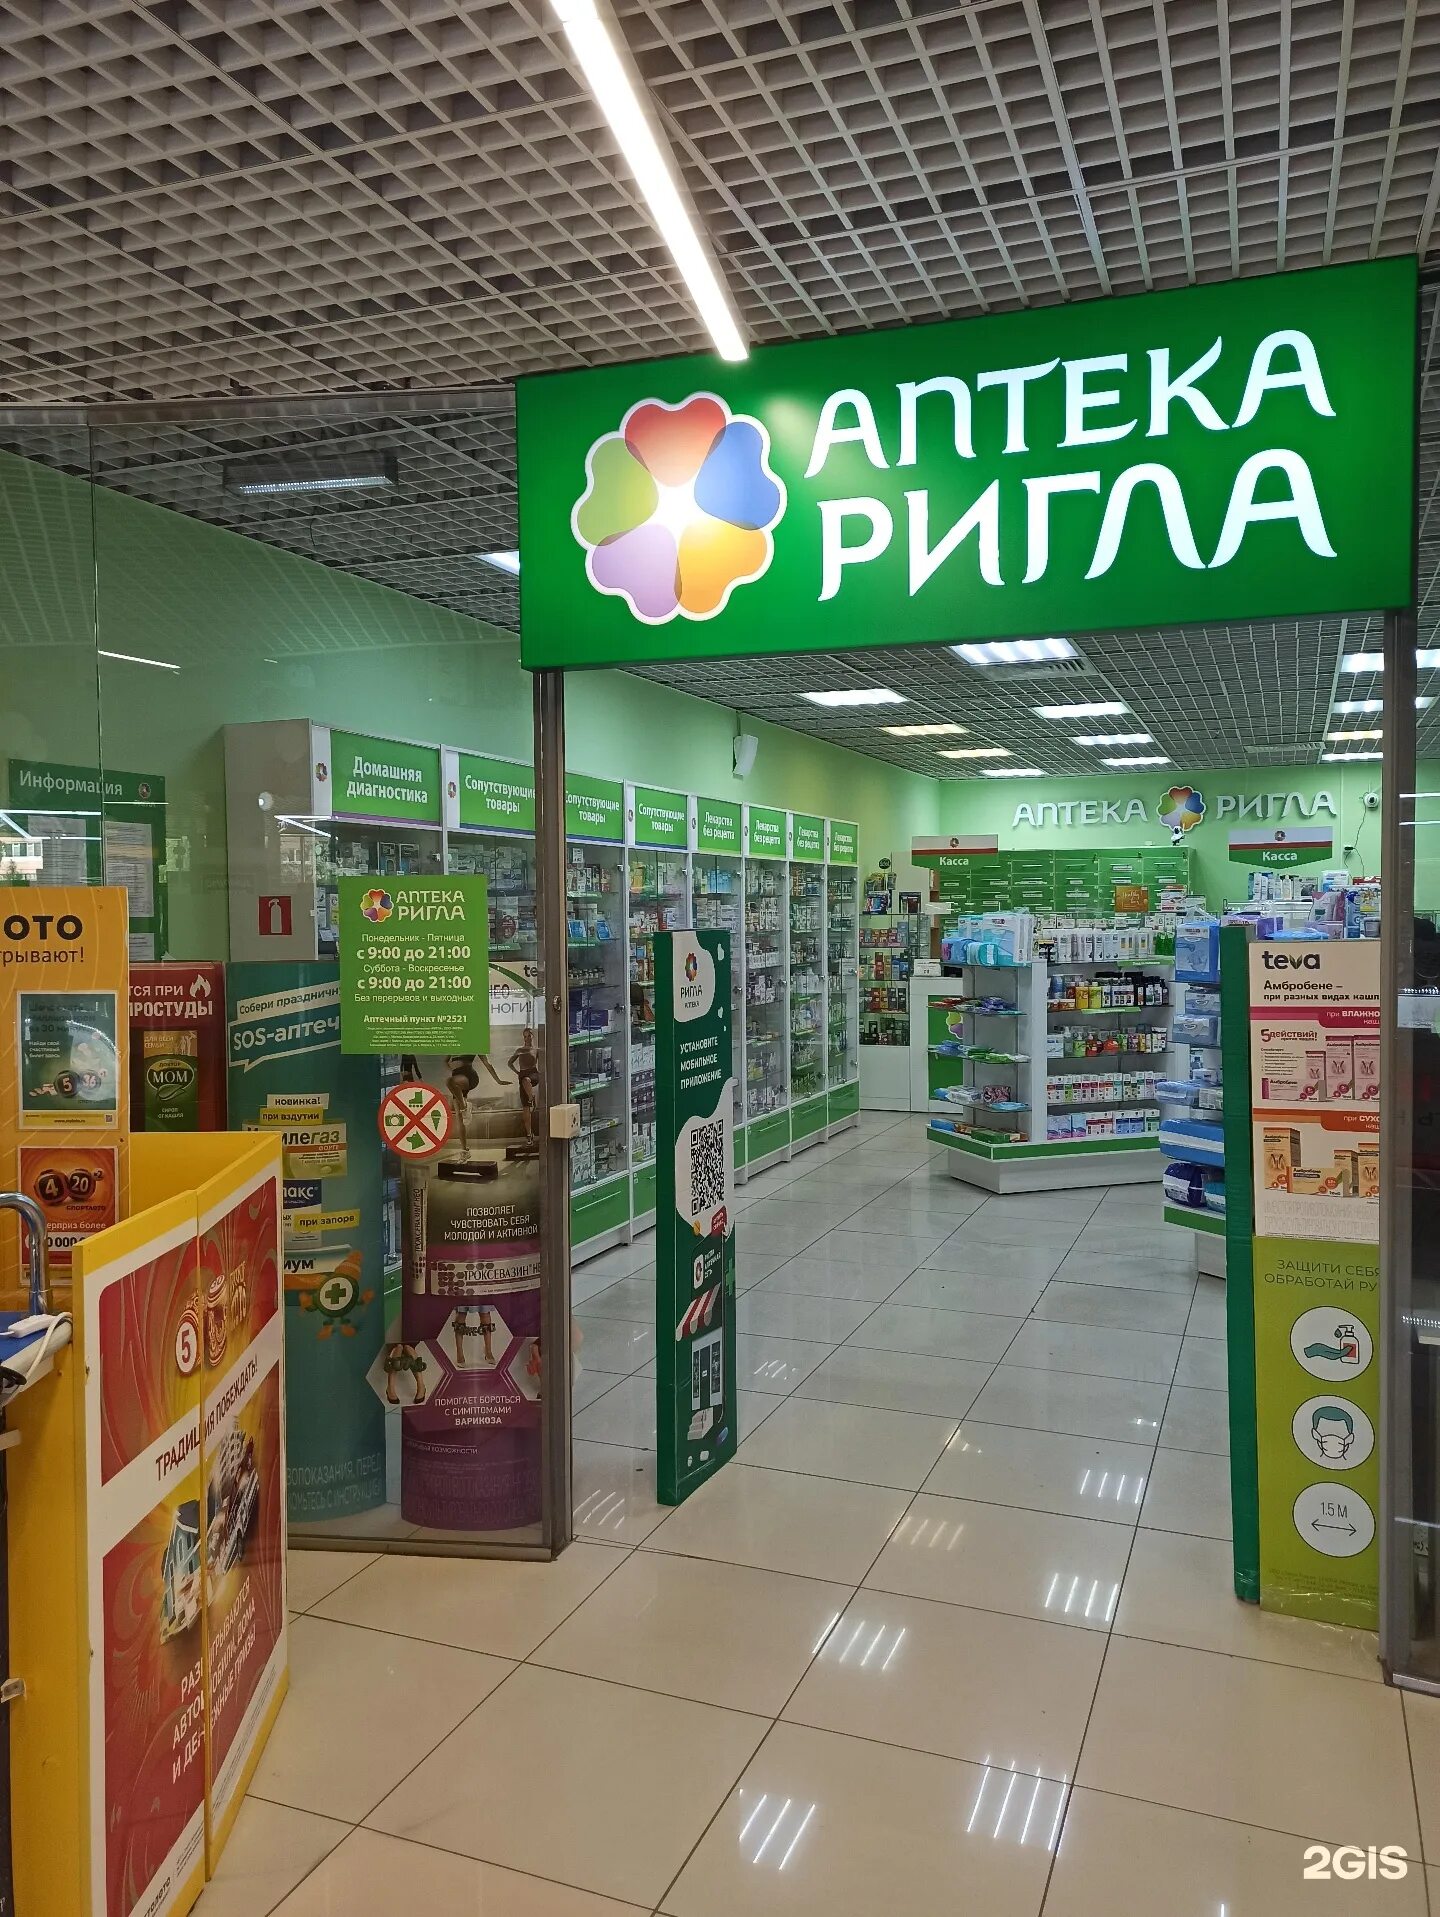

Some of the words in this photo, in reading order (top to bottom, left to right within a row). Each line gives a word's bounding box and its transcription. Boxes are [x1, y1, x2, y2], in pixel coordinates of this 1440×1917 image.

[803, 328, 1337, 479] АПТЕКА
[815, 447, 1337, 601] РИГЛА
[353, 756, 422, 783] Домашняя
[19, 770, 123, 795] Информация
[347, 781, 428, 804] диагностика
[486, 797, 520, 815] товары
[639, 803, 685, 821] Сопутствующие
[1012, 798, 1148, 828] АПТЕКА
[1216, 790, 1338, 821] РИГЛА
[578, 810, 606, 825] товары
[705, 812, 733, 826] Лекарства
[652, 820, 674, 835] товары
[703, 825, 713, 837] без
[714, 828, 735, 840] рецепта
[755, 819, 779, 834] Лекарства
[799, 826, 819, 840] Лекарства
[753, 832, 762, 843] без
[939, 855, 969, 867] Касса
[1262, 850, 1298, 862] Касса
[396, 890, 465, 903] АПТЕКА
[398, 905, 466, 921] РИГЛА
[4, 915, 83, 940] ОТО
[362, 934, 420, 942] Понедельник
[427, 933, 465, 943] Пятница
[0, 946, 84, 967] рывают!
[357, 950, 364, 959] с
[367, 946, 401, 959] 9:00
[404, 949, 424, 961] до
[428, 946, 471, 959] 21:00
[1261, 951, 1320, 970] teva
[363, 964, 400, 974] Суббота
[409, 964, 465, 973] Воскресенье
[155, 985, 184, 996] ПРИ
[357, 979, 365, 989] с
[368, 977, 401, 989] 9:00
[405, 979, 424, 991] до
[428, 976, 472, 989] 21:00
[1263, 980, 1333, 991] Амбробене
[355, 994, 370, 1002] Без
[373, 995, 420, 1003] перерывов
[430, 995, 474, 1003] выходных
[680, 985, 703, 998] РИГЛА
[1263, 994, 1281, 1002] при
[239, 1001, 274, 1014] Собери
[276, 987, 340, 1007] праздничн
[491, 1001, 532, 1014] НОГИ!
[363, 1015, 408, 1023] Аптечный
[410, 1017, 436, 1025] пункт
[437, 1015, 467, 1023] №2521
[680, 1036, 719, 1055] УСТАНОВИТЕ
[680, 1053, 718, 1072] МОБИЛЬНОЕ
[62, 1077, 72, 1092] 5
[83, 1074, 96, 1087] 36
[153, 1071, 188, 1083] МОМ
[680, 1069, 722, 1090] ПРИЛОЖЕНИЕ
[274, 1097, 321, 1106] новинка!
[262, 1113, 279, 1121] при
[281, 1112, 320, 1121] вздутии
[45, 1178, 59, 1197] 4
[71, 1175, 89, 1193] 20
[466, 1204, 516, 1217] ПОЗВОЛЯЕТ
[79, 1221, 106, 1229] более
[299, 1218, 318, 1227] при
[320, 1215, 355, 1225] запоре
[450, 1217, 509, 1229] ЧУВСТВОВАТЬ
[510, 1215, 530, 1225] СЕБЯ
[444, 1229, 486, 1241] МОЛОДОЙ
[488, 1231, 495, 1239] И
[497, 1224, 539, 1239] АКТИВНОЙ
[1277, 1259, 1341, 1273] ЗАЩИТИ
[1264, 1273, 1354, 1291] ОБРАБОТАЙ
[1359, 1281, 1378, 1292] РУ
[181, 1330, 191, 1363] 5
[216, 1354, 258, 1424] ПОБЕЖДАТЬ!
[434, 1396, 478, 1406] ПОМОГАЕТ
[480, 1395, 521, 1404] БОРОТЬСЯ
[445, 1408, 450, 1416] С
[452, 1406, 512, 1416] СИМПТОМАМИ
[455, 1416, 502, 1426] ВАРИКОЗА
[1337, 1503, 1348, 1519] М
[172, 1755, 181, 1784] И
